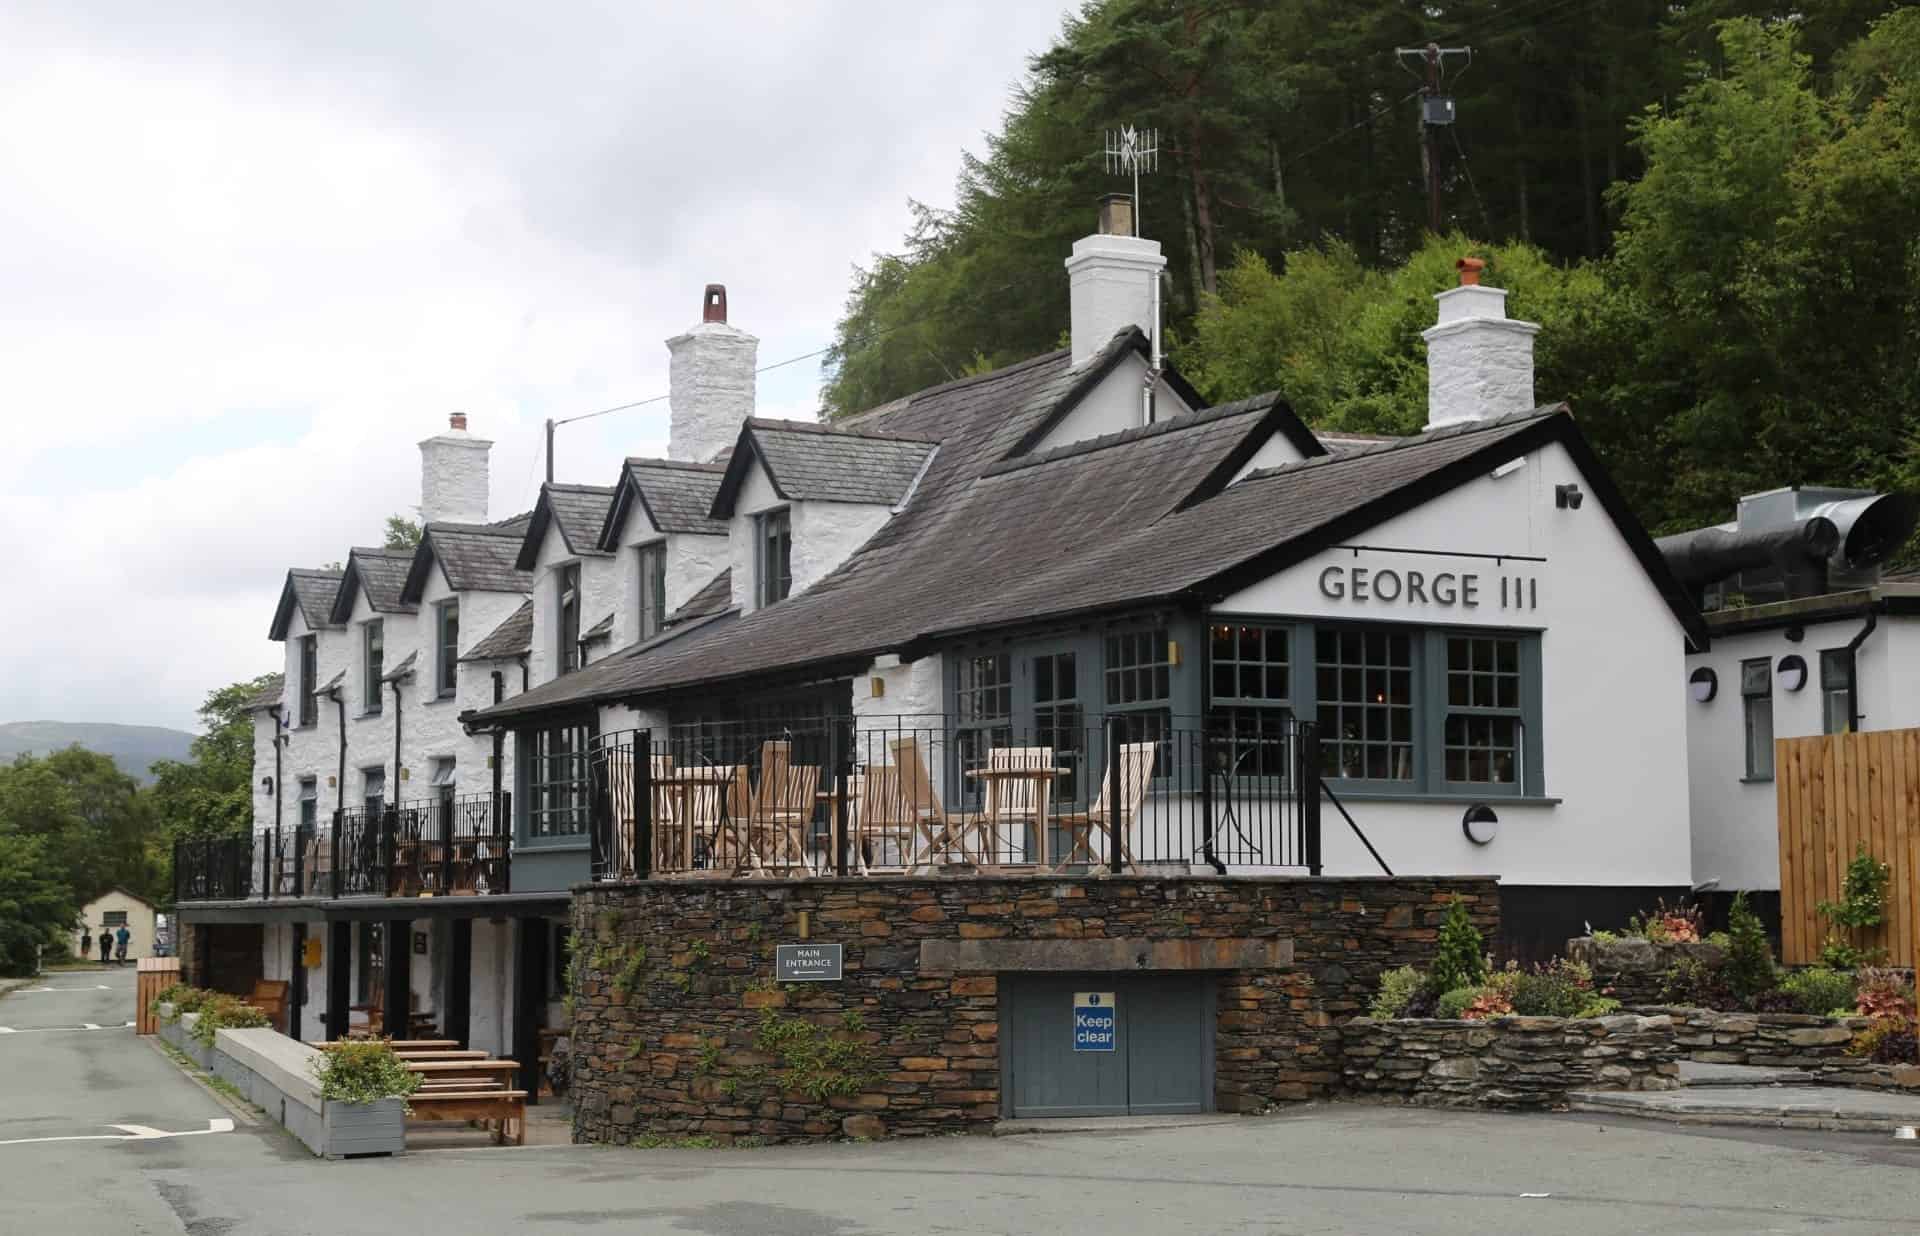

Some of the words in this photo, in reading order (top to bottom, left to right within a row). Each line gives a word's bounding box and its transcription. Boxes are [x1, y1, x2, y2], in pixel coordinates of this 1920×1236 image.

[1319, 566, 1479, 607] GEORGE
[797, 949, 820, 957] MAIN
[785, 959, 832, 967] ENTRANCE
[1076, 1015, 1112, 1029] Keep
[1077, 1030, 1112, 1043] clear
